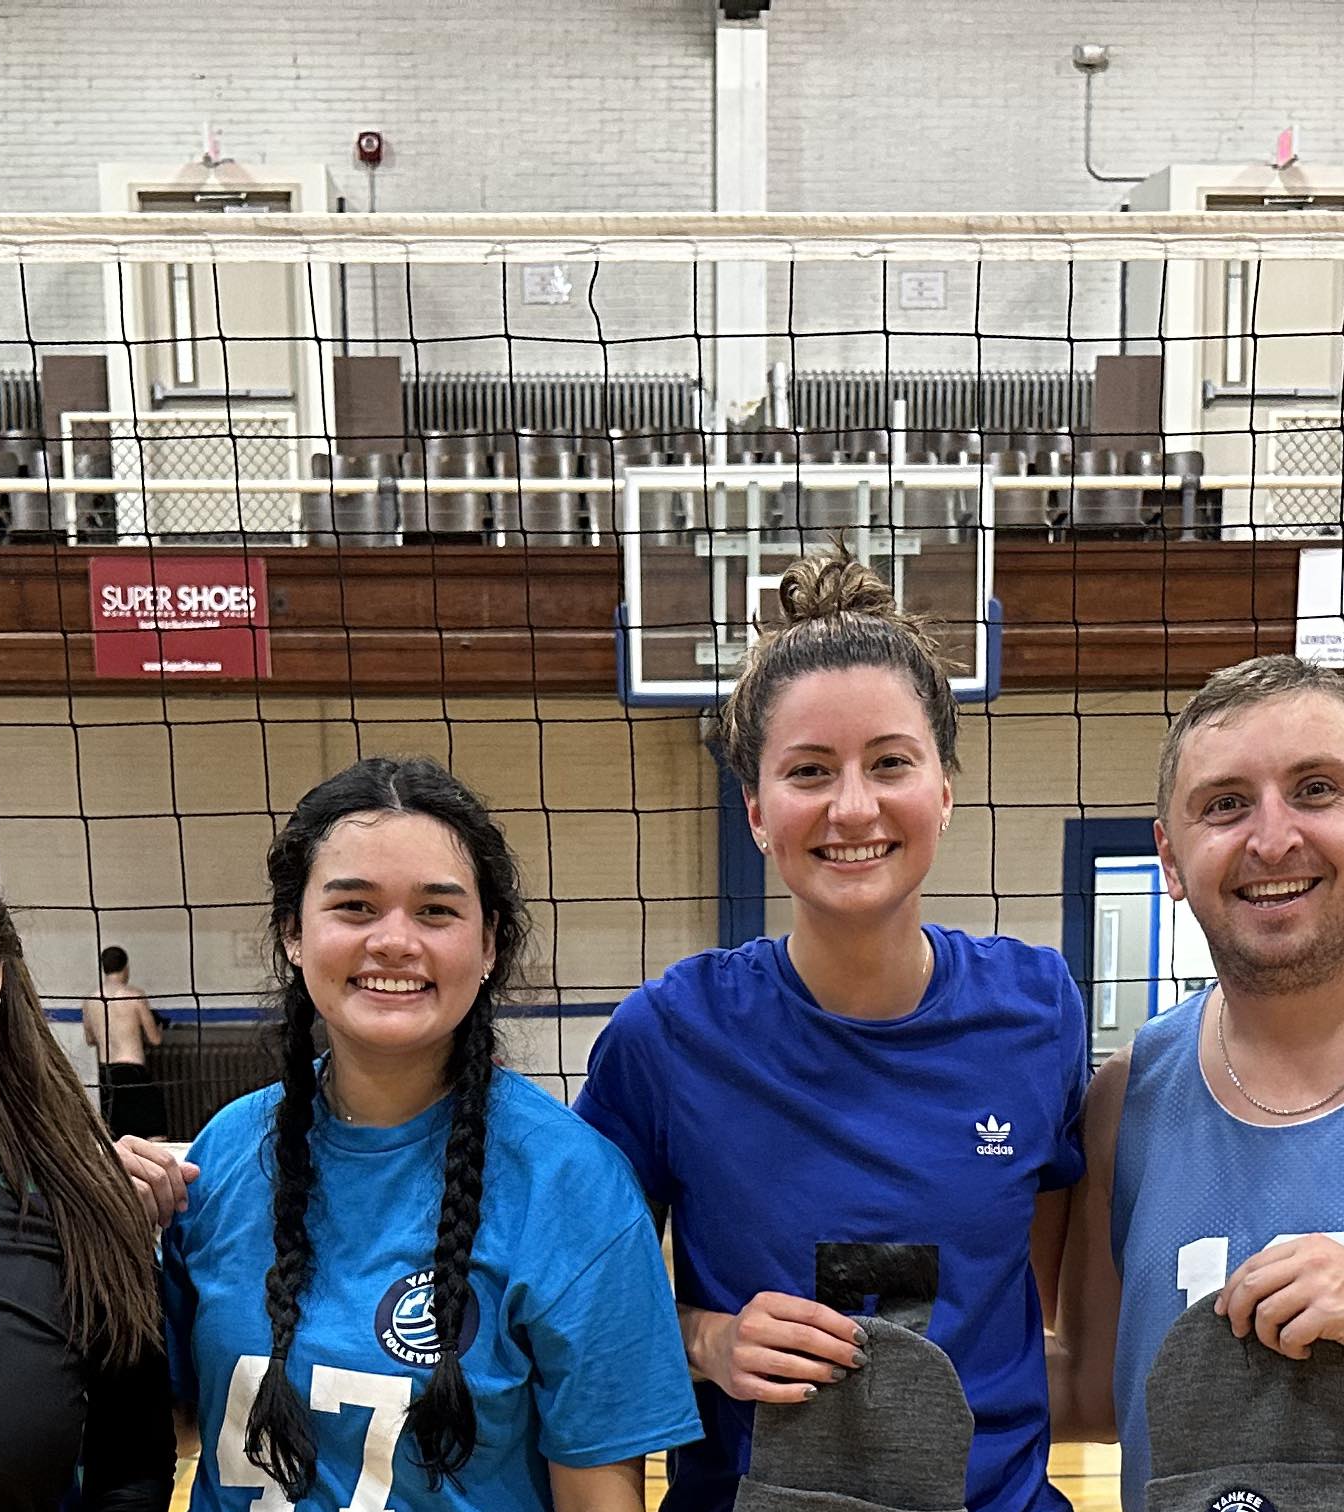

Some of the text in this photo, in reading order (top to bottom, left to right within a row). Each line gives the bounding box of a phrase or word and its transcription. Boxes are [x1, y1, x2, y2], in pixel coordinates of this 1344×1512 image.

[101, 585, 256, 611] SUPER SHOES
[976, 1143, 1014, 1156] adidas
[1212, 1491, 1264, 1511] YANKEE
